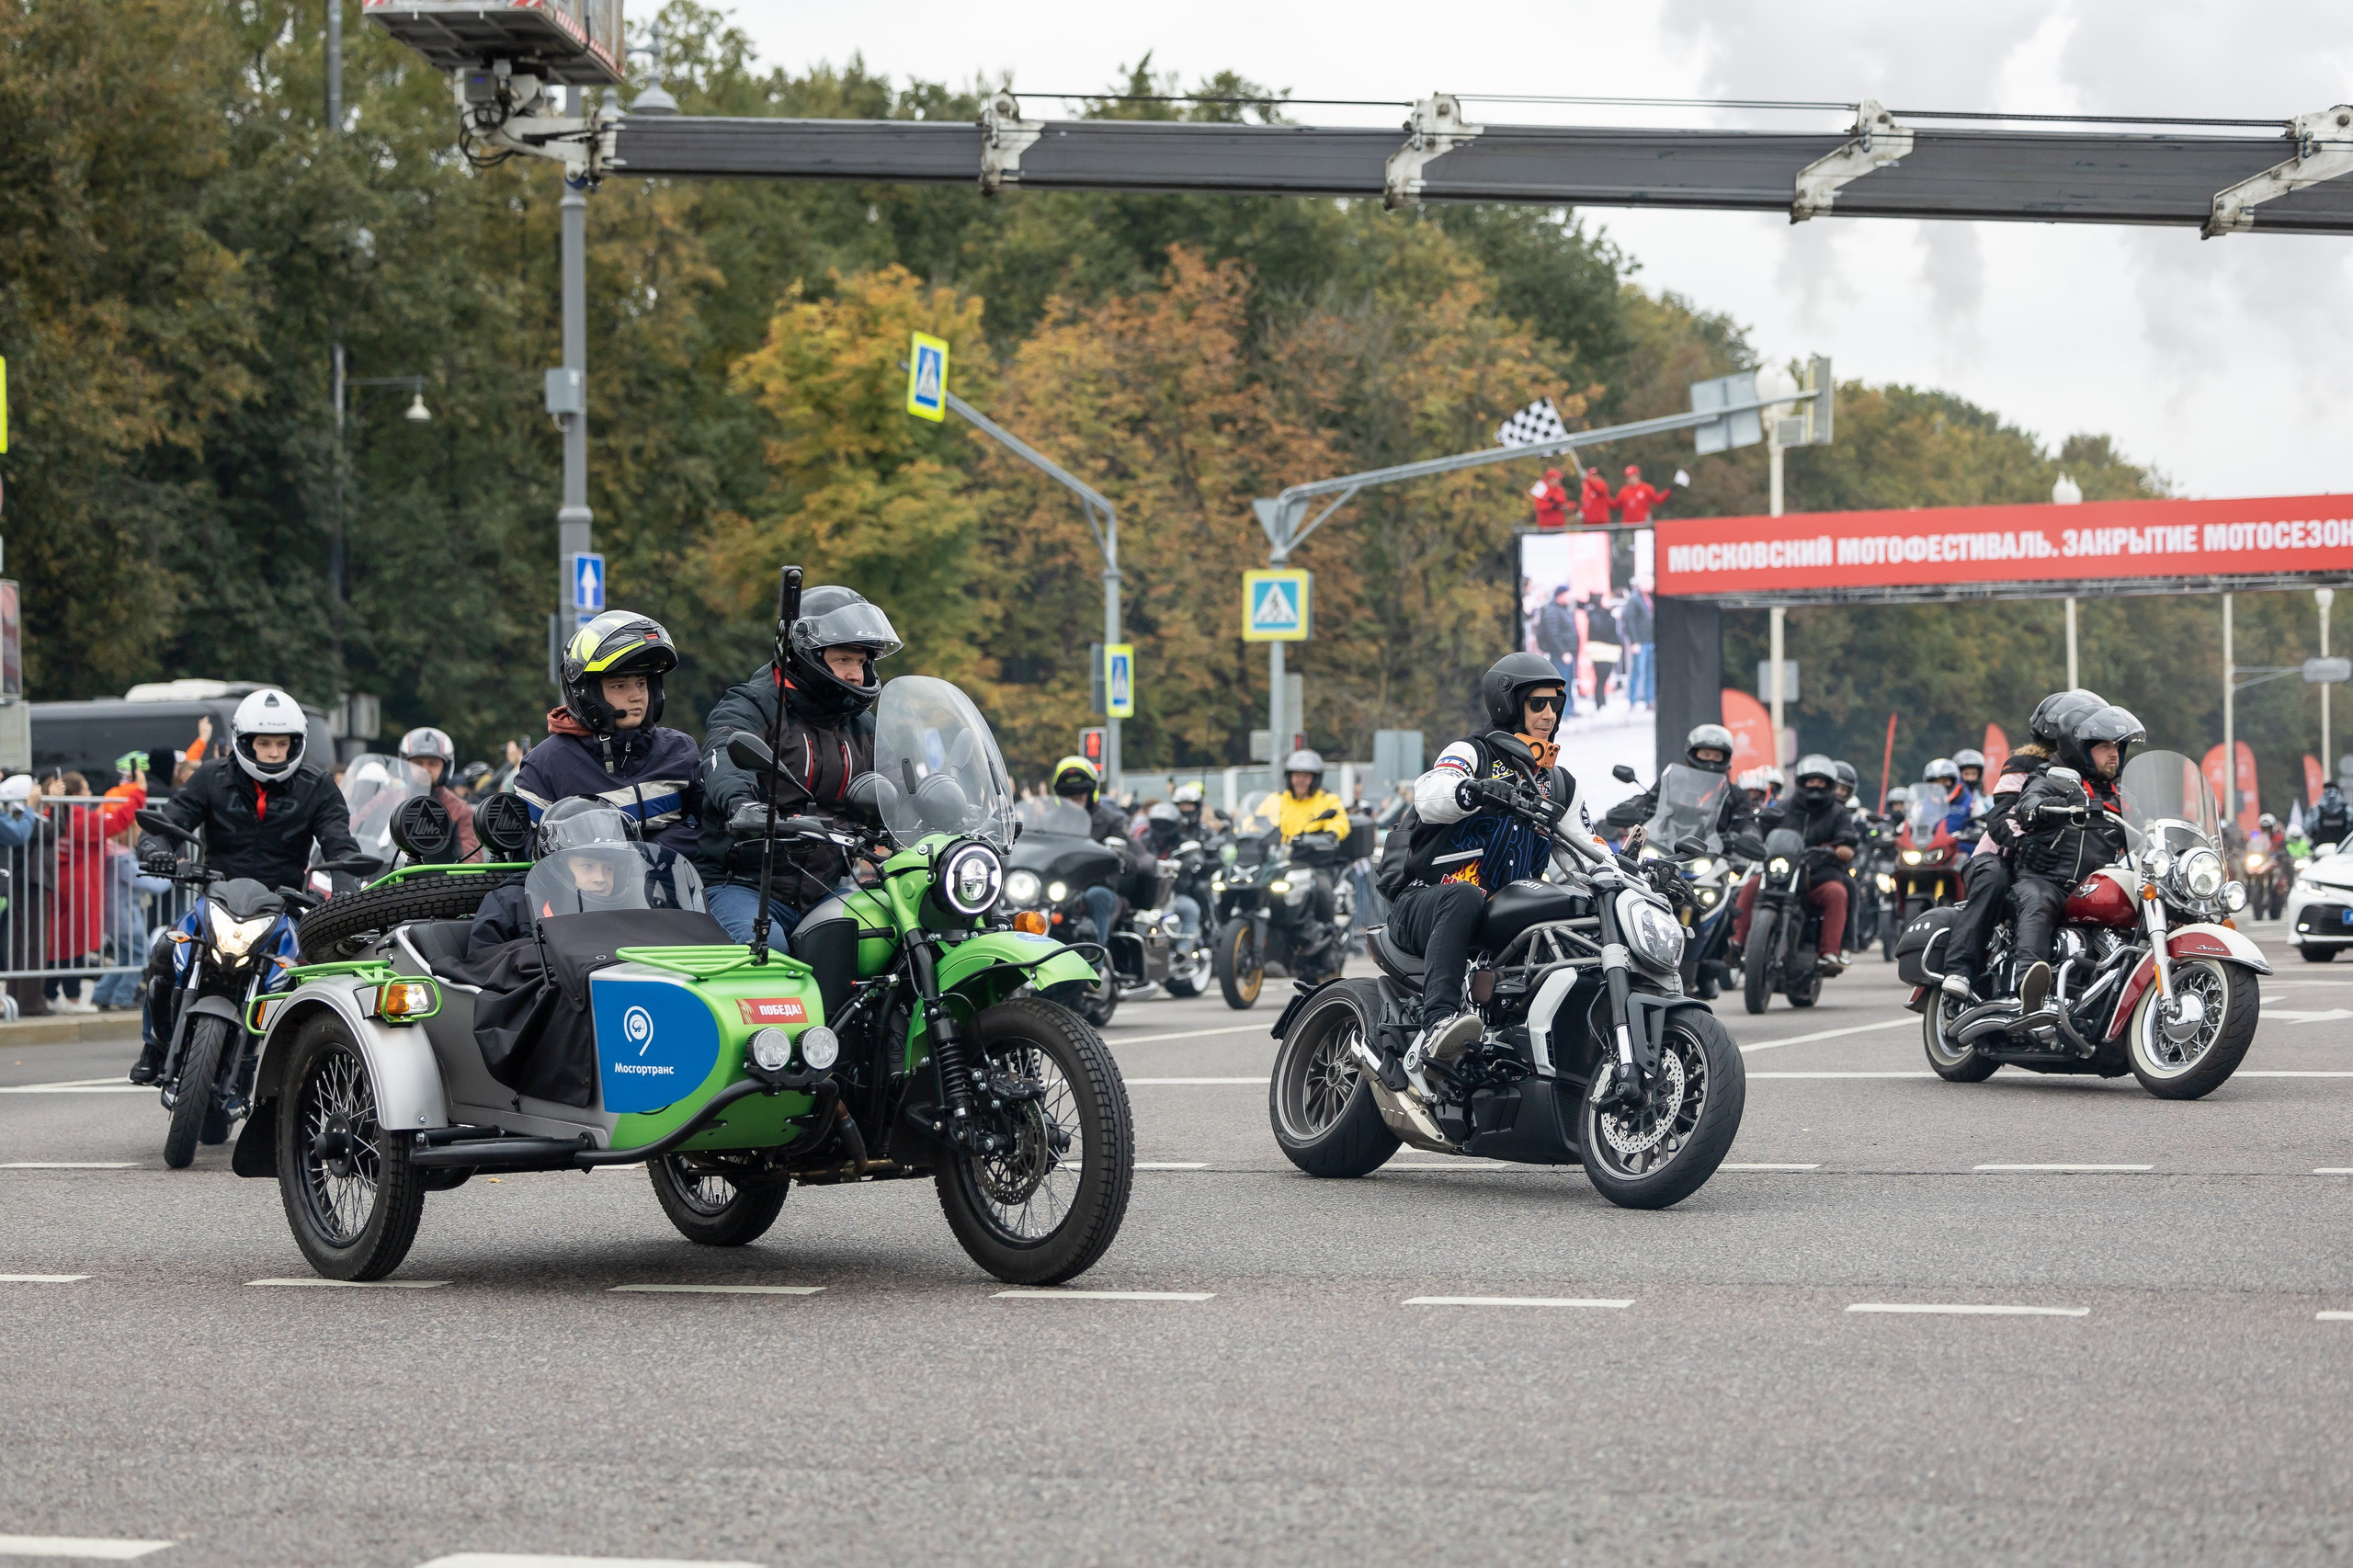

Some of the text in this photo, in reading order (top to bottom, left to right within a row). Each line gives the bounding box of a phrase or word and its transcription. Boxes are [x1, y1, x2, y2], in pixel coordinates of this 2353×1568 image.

[1667, 535, 1833, 574] МОСКОВСКИЙ
[1837, 529, 2059, 566] МОТОФЕСТИВАЛЬ.
[2062, 524, 2199, 558] ЗАКРЫТИЕ
[759, 1005, 802, 1016] ПОБЕДА!
[614, 1062, 675, 1076] Мосгортранс
